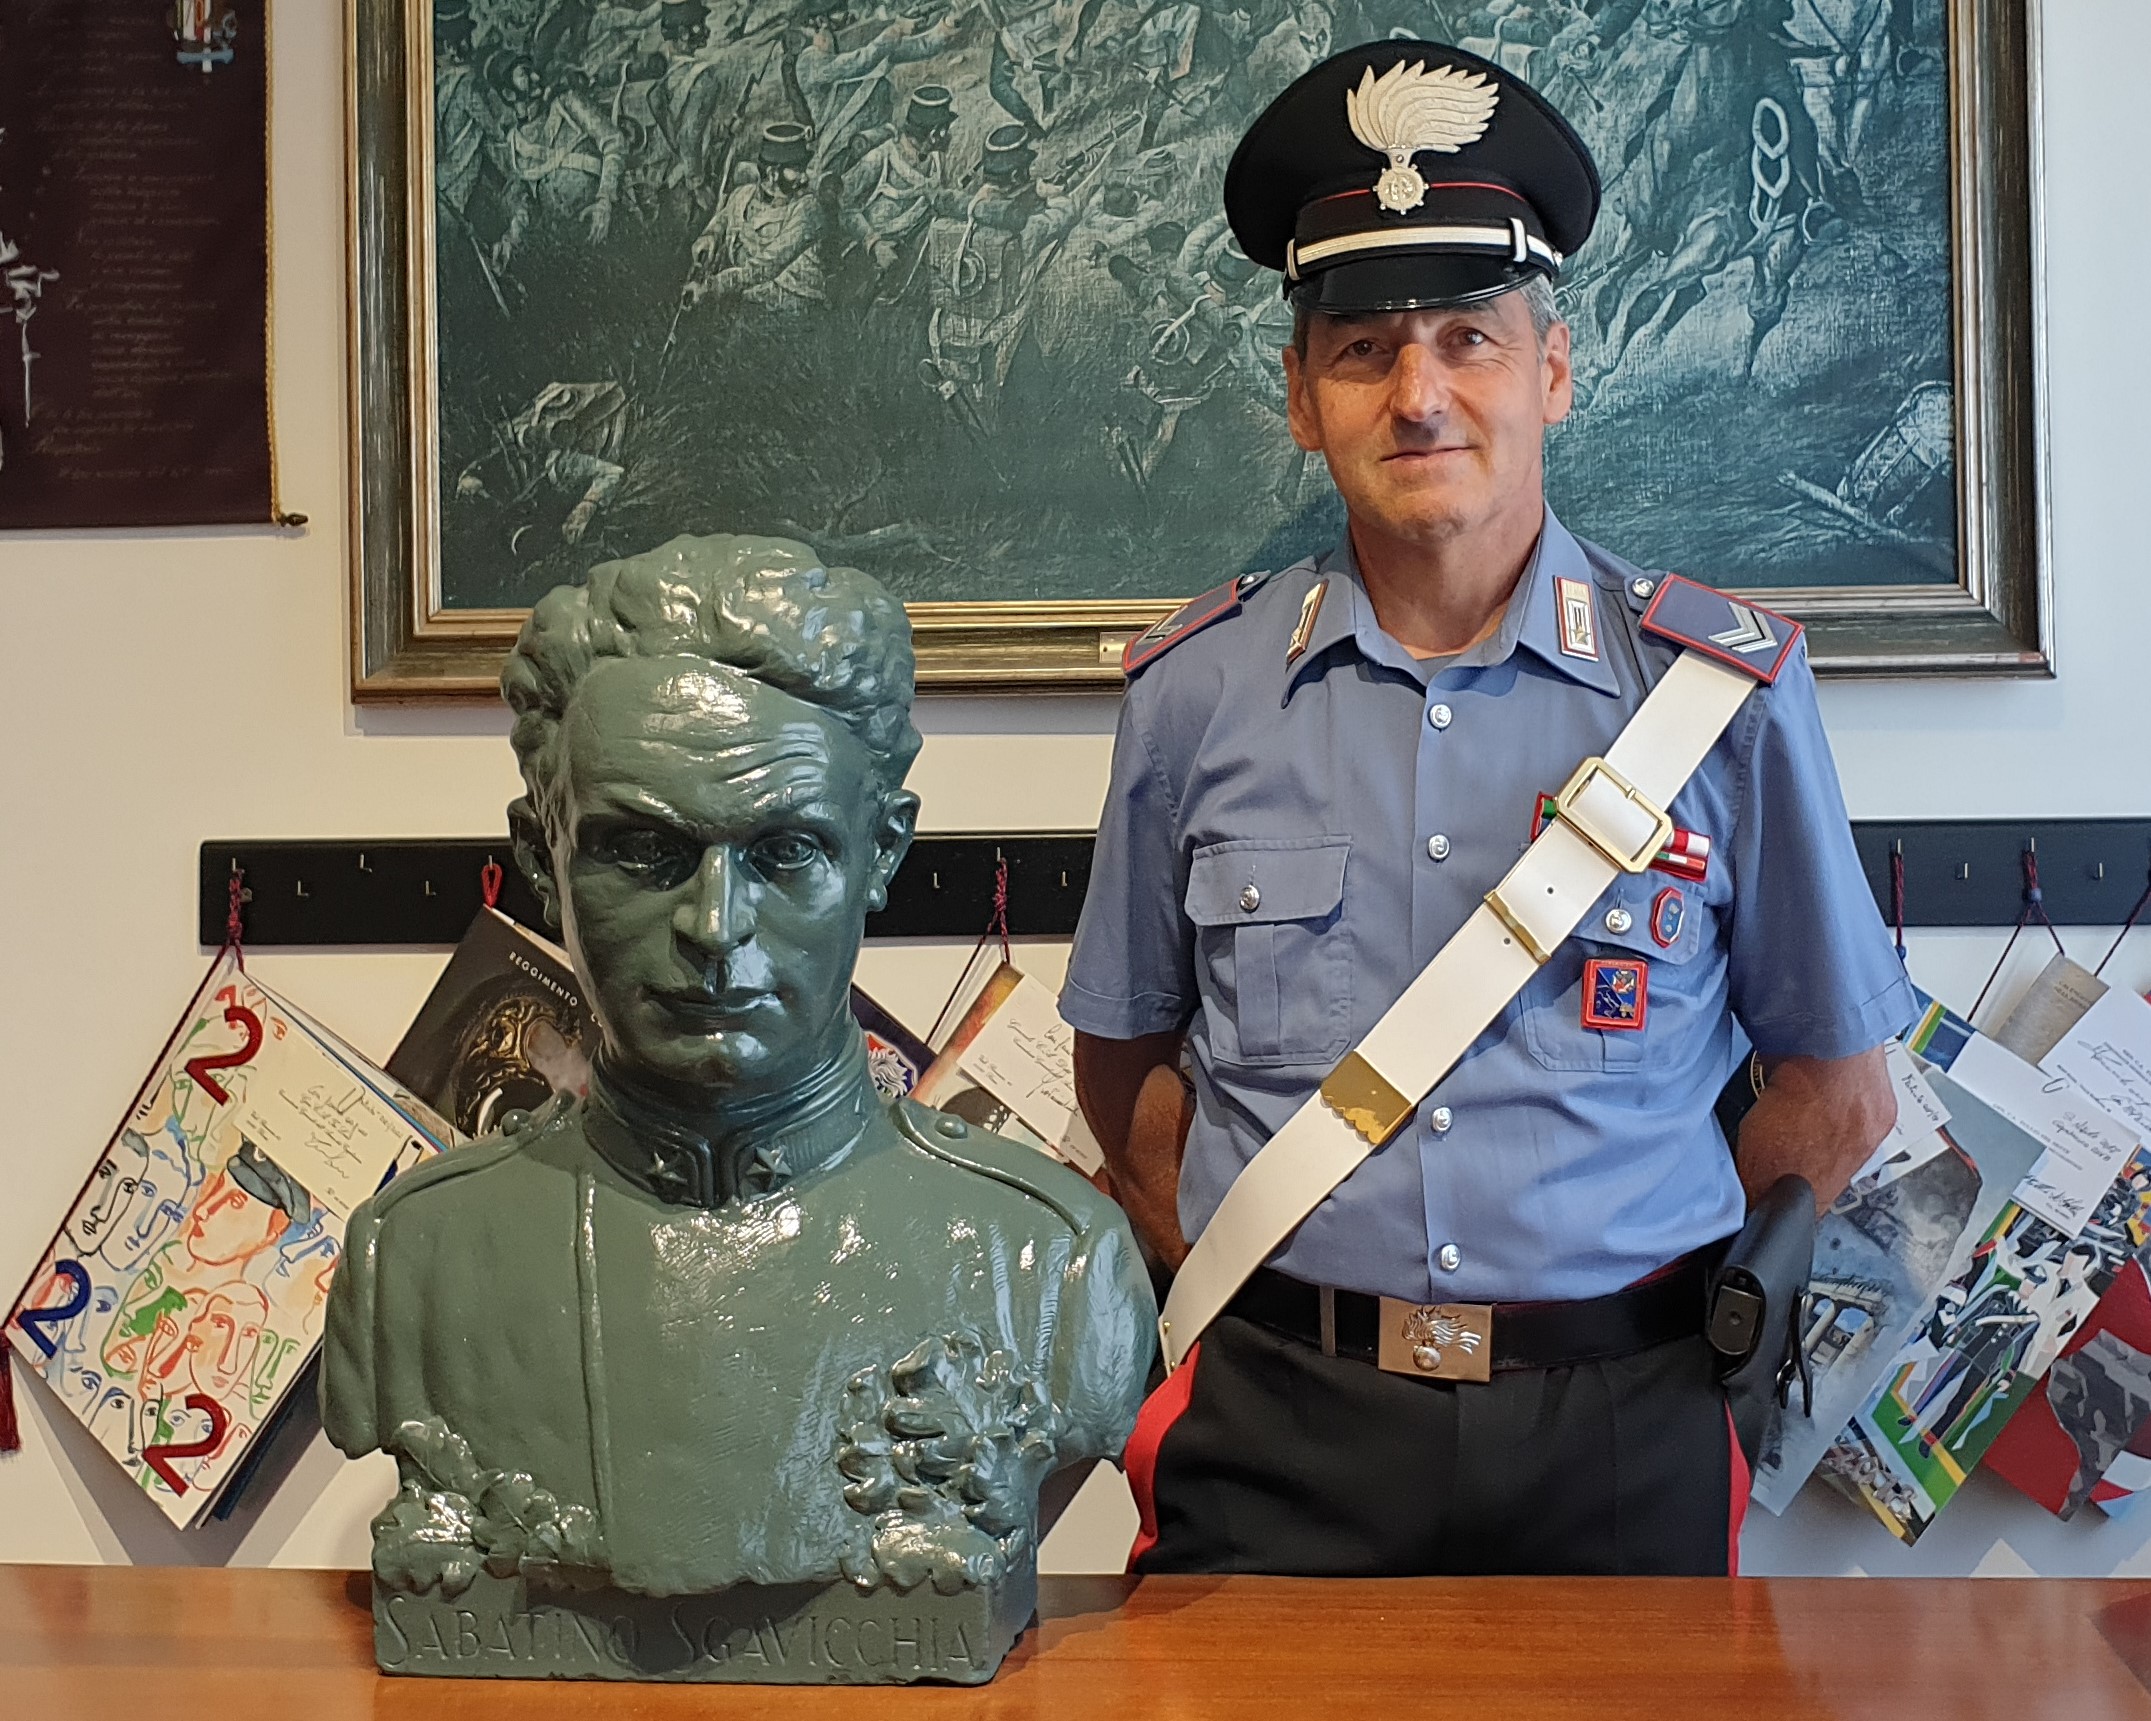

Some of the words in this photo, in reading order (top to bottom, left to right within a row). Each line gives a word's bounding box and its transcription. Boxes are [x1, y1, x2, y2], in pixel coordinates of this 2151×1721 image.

[509, 951, 578, 1006] REGGIMENTO
[185, 1006, 263, 1106] 2
[17, 1259, 92, 1360] 2
[142, 1394, 224, 1497] 2
[380, 1595, 642, 1668] SABATINO
